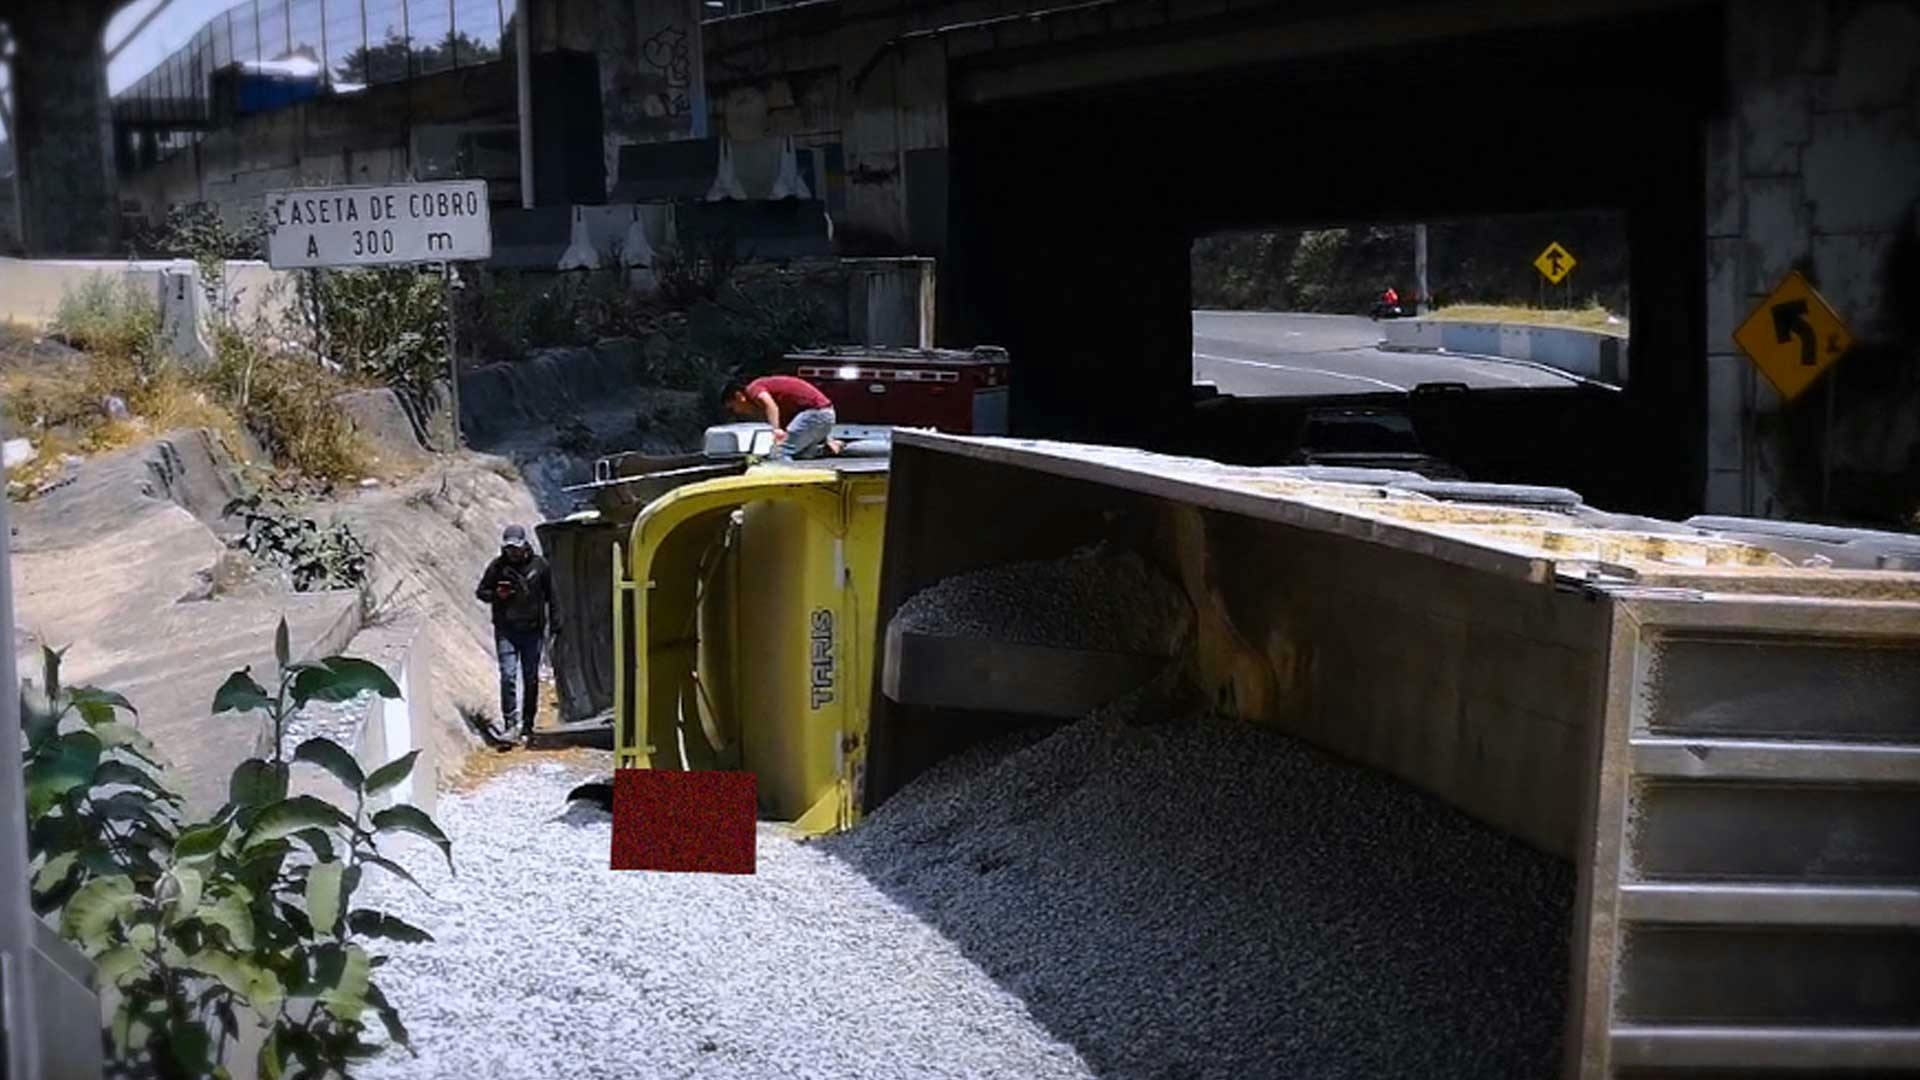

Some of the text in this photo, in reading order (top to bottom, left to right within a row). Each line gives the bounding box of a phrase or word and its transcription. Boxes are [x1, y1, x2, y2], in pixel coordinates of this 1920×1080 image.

[275, 191, 477, 226] CASETA DE COBRO
[306, 229, 453, 258] A 300 m
[810, 609, 834, 710] TARIS
